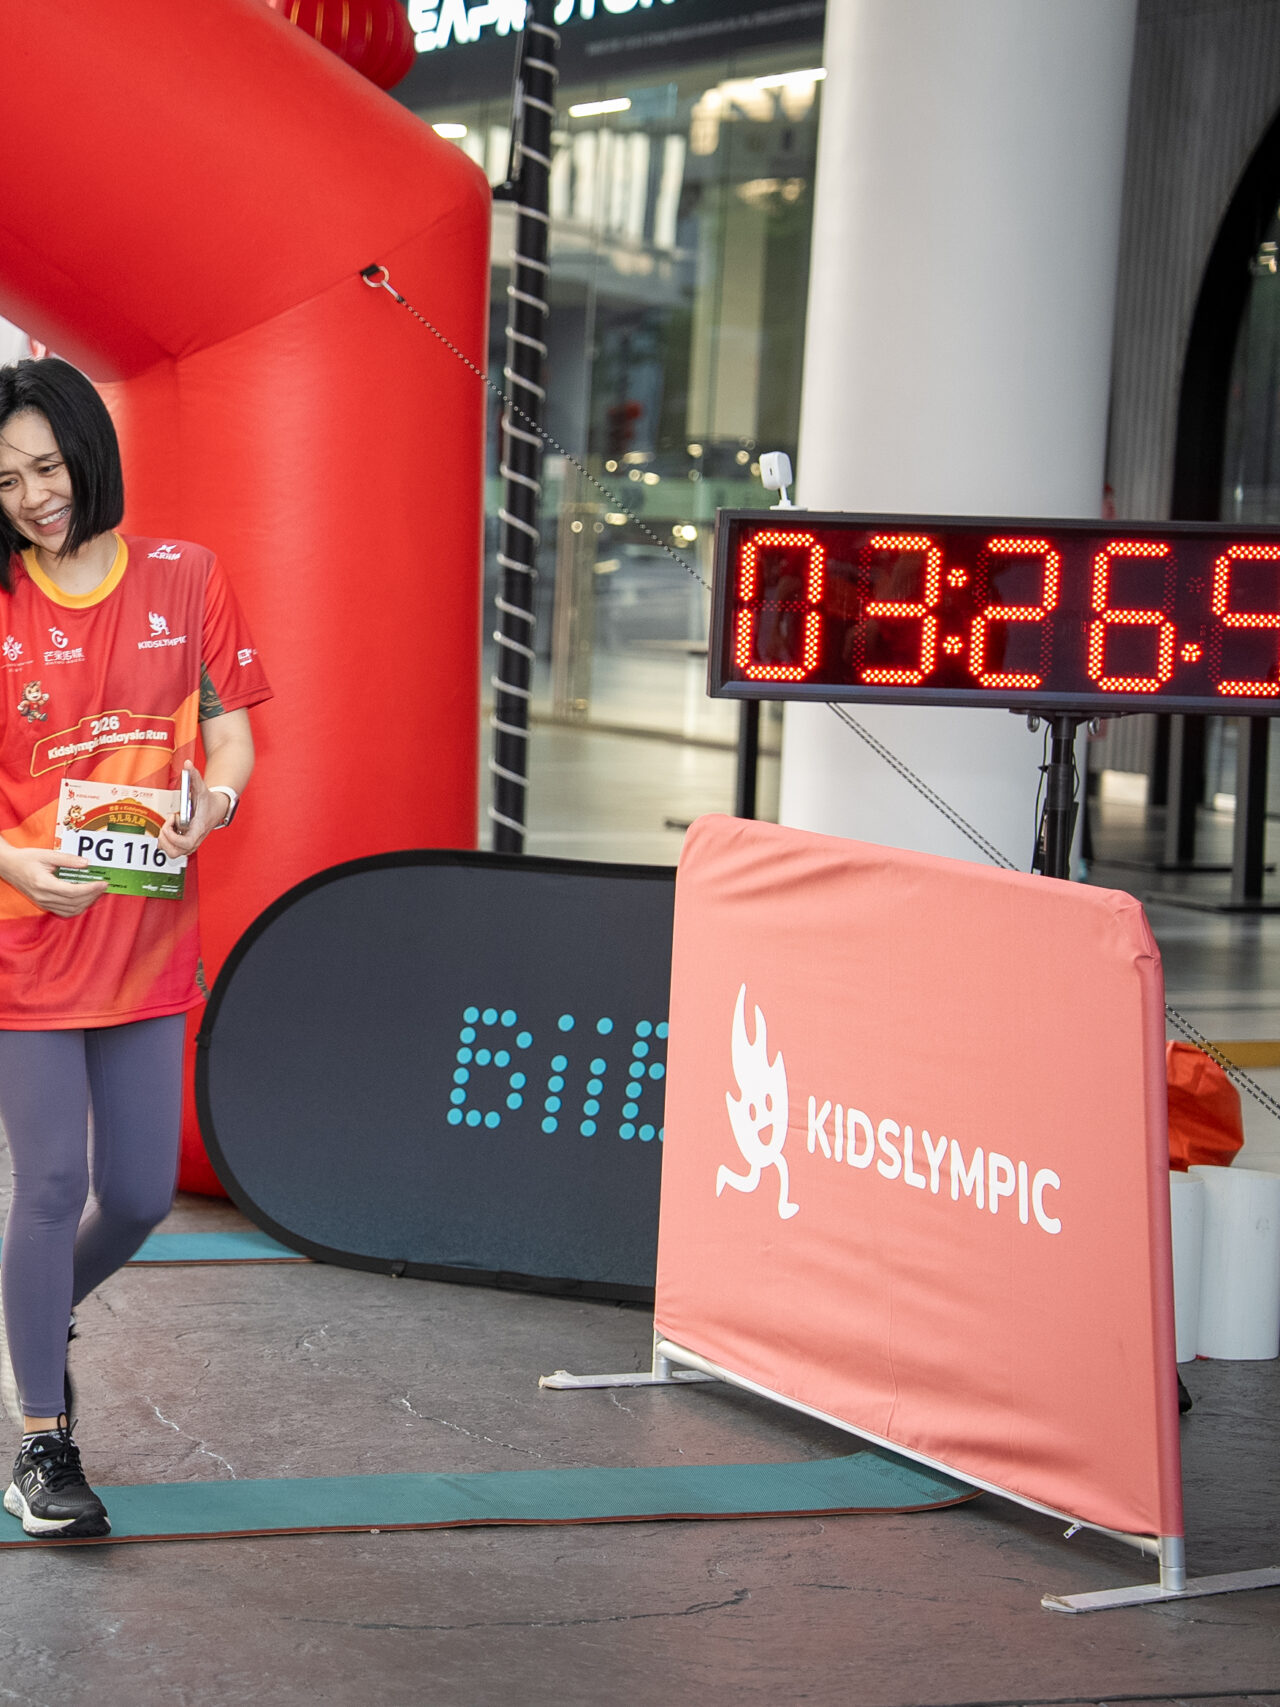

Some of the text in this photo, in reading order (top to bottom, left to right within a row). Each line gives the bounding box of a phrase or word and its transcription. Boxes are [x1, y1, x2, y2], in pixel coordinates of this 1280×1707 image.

[138, 635, 187, 649] KIDSLYMPIC
[145, 730, 168, 741] Run
[78, 836, 167, 867] PG 116
[807, 1095, 1062, 1234] KIDSLYMPIC
